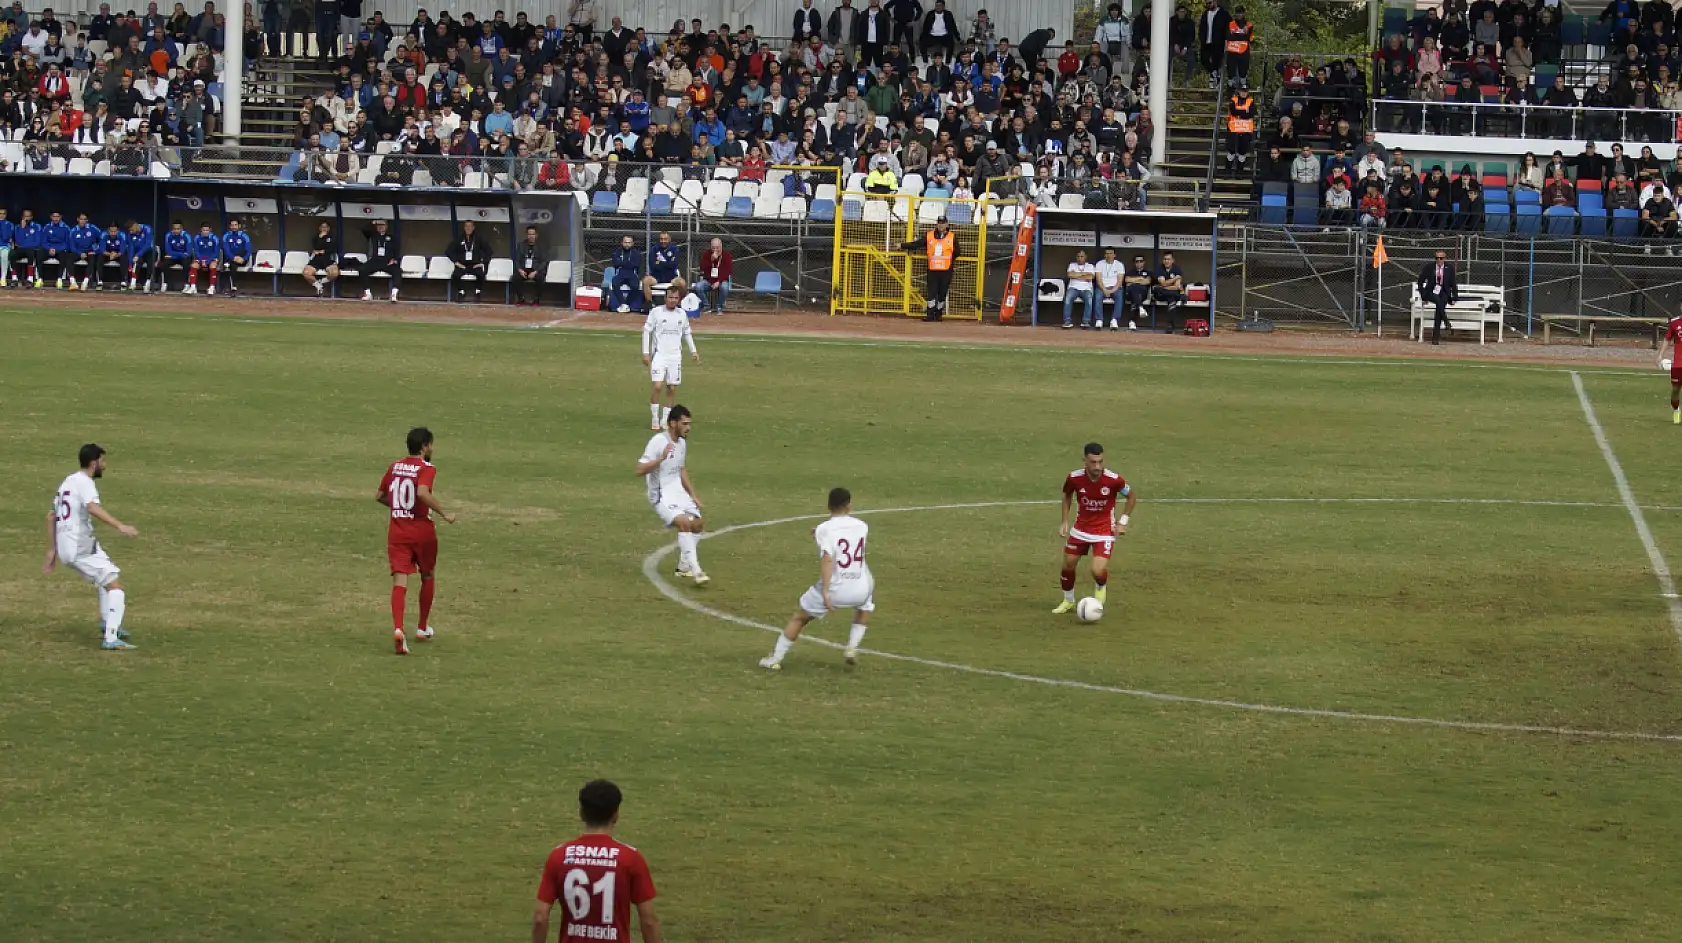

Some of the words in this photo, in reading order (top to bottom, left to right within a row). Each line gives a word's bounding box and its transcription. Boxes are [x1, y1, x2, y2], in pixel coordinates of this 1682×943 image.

[389, 477, 415, 510] 10
[836, 537, 864, 569] 34
[565, 845, 620, 859] ESNAF
[563, 868, 616, 924] 61
